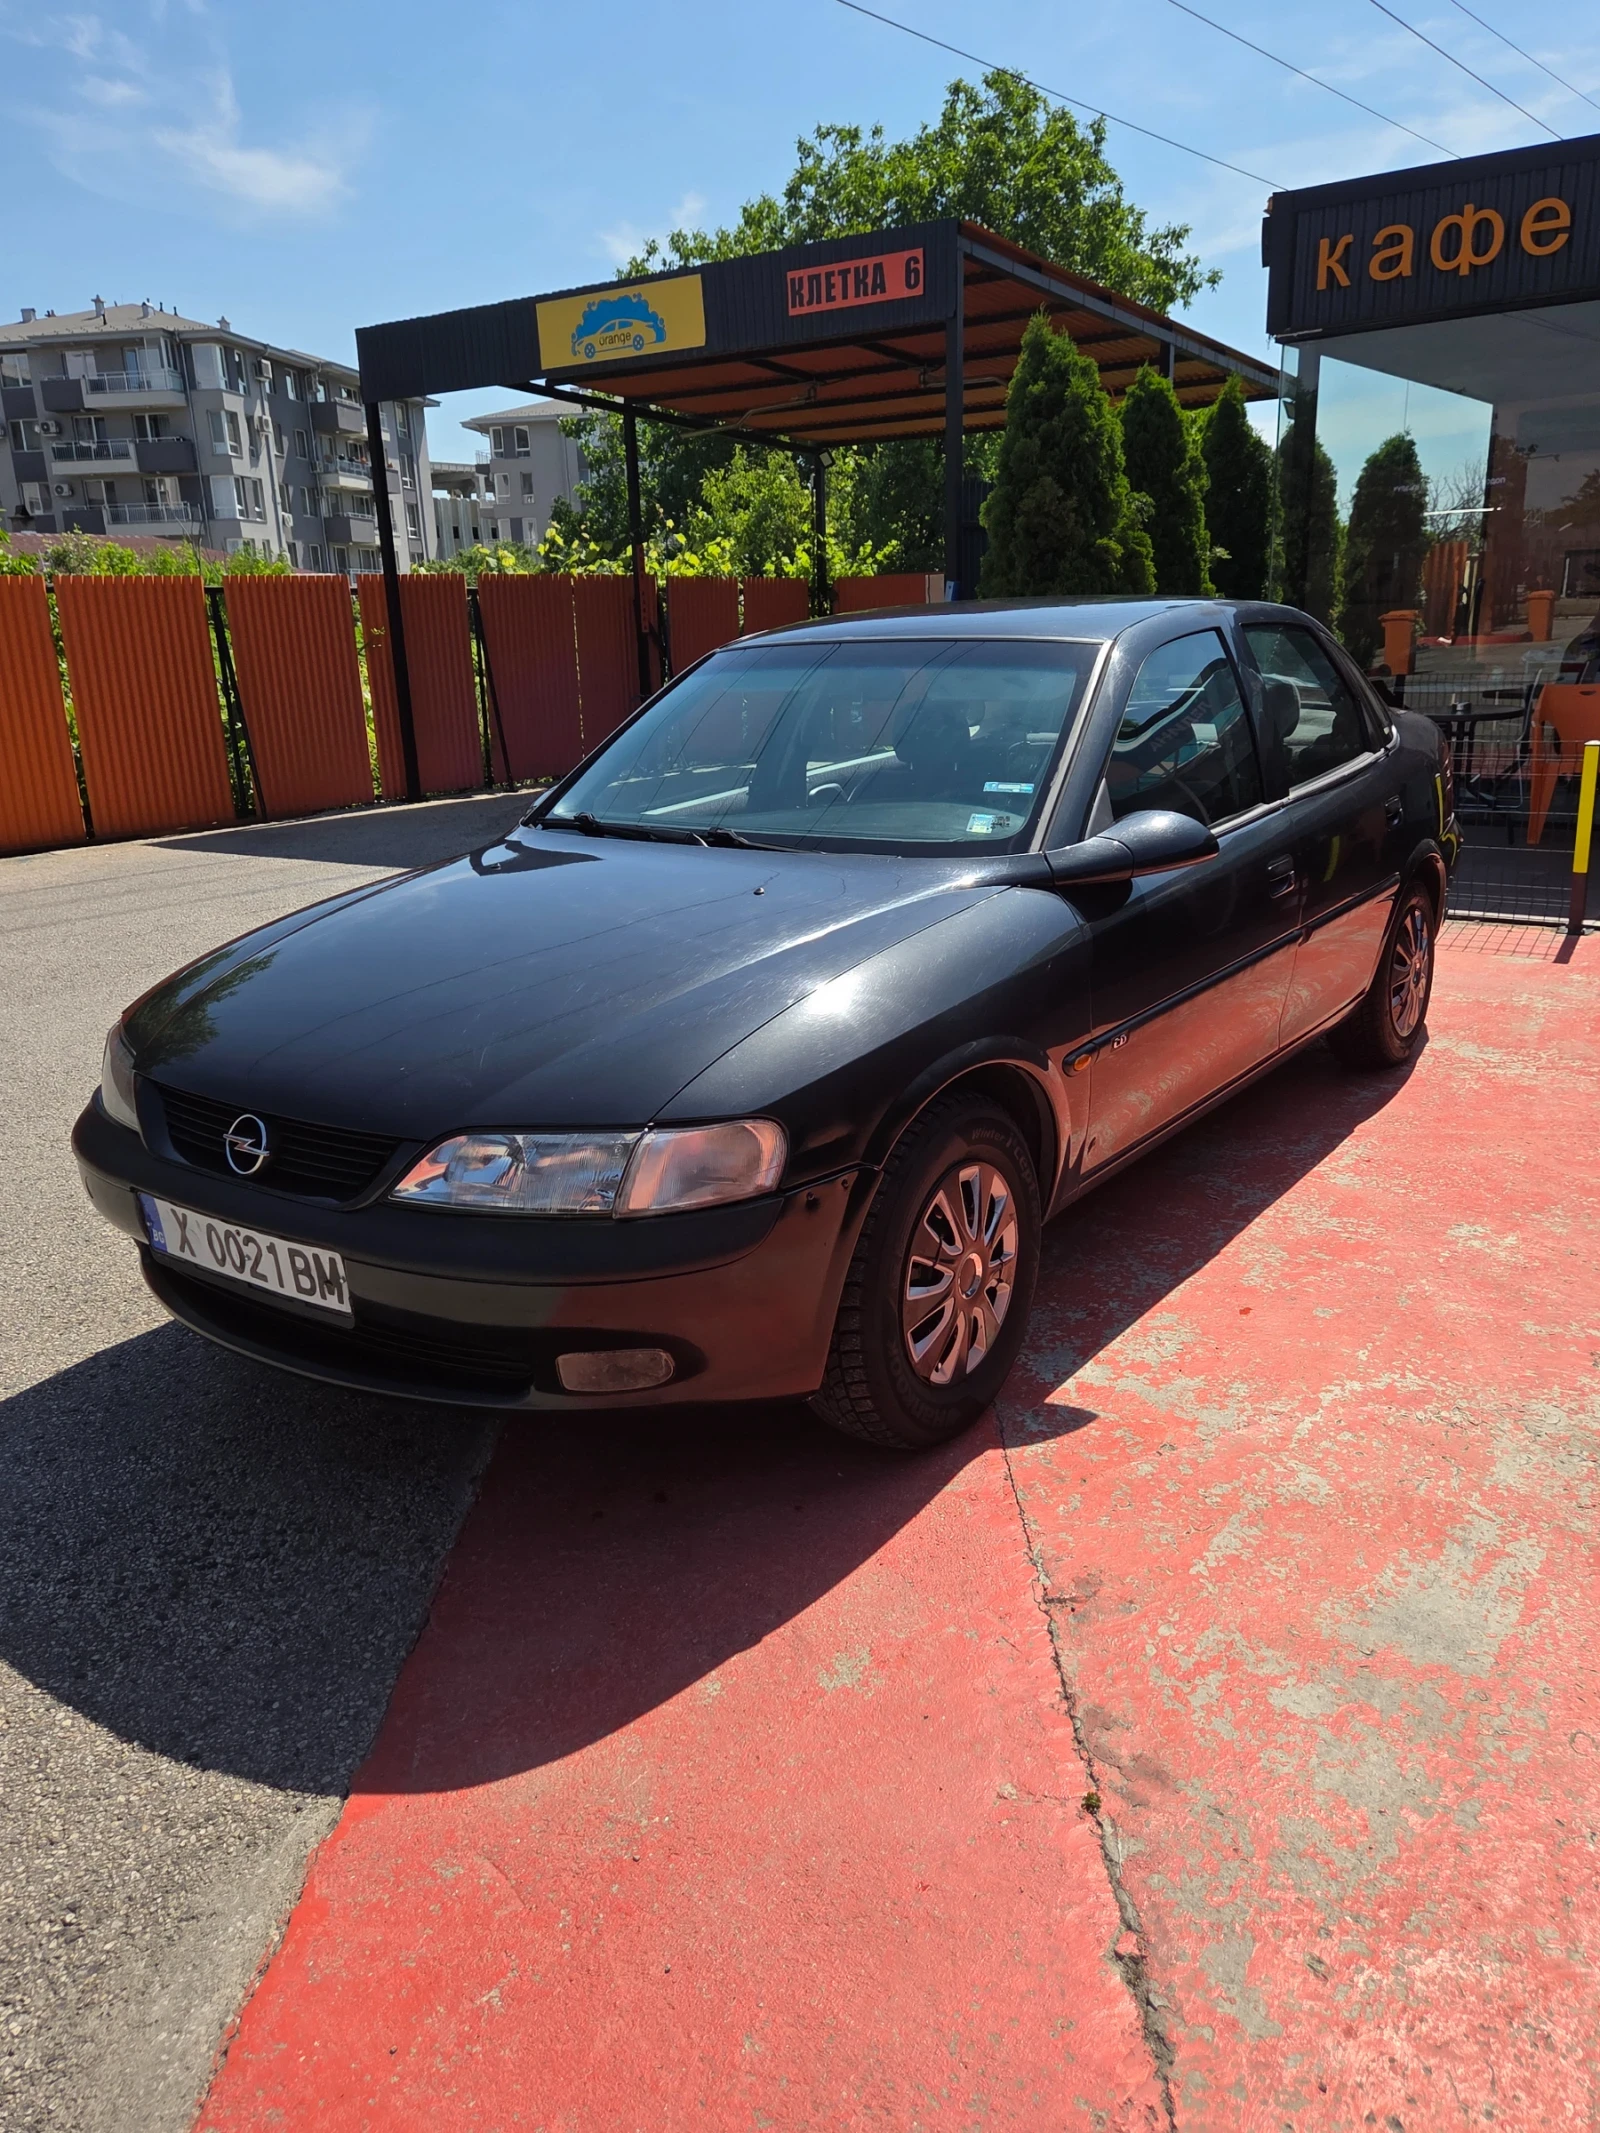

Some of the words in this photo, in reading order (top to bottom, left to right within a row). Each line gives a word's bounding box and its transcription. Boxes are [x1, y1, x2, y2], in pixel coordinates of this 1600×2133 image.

[1316, 197, 1571, 291] кафе
[789, 261, 887, 309] КЛЕТКА
[904, 256, 921, 290] 6
[599, 332, 632, 346] orange
[152, 1229, 165, 1244] BG
